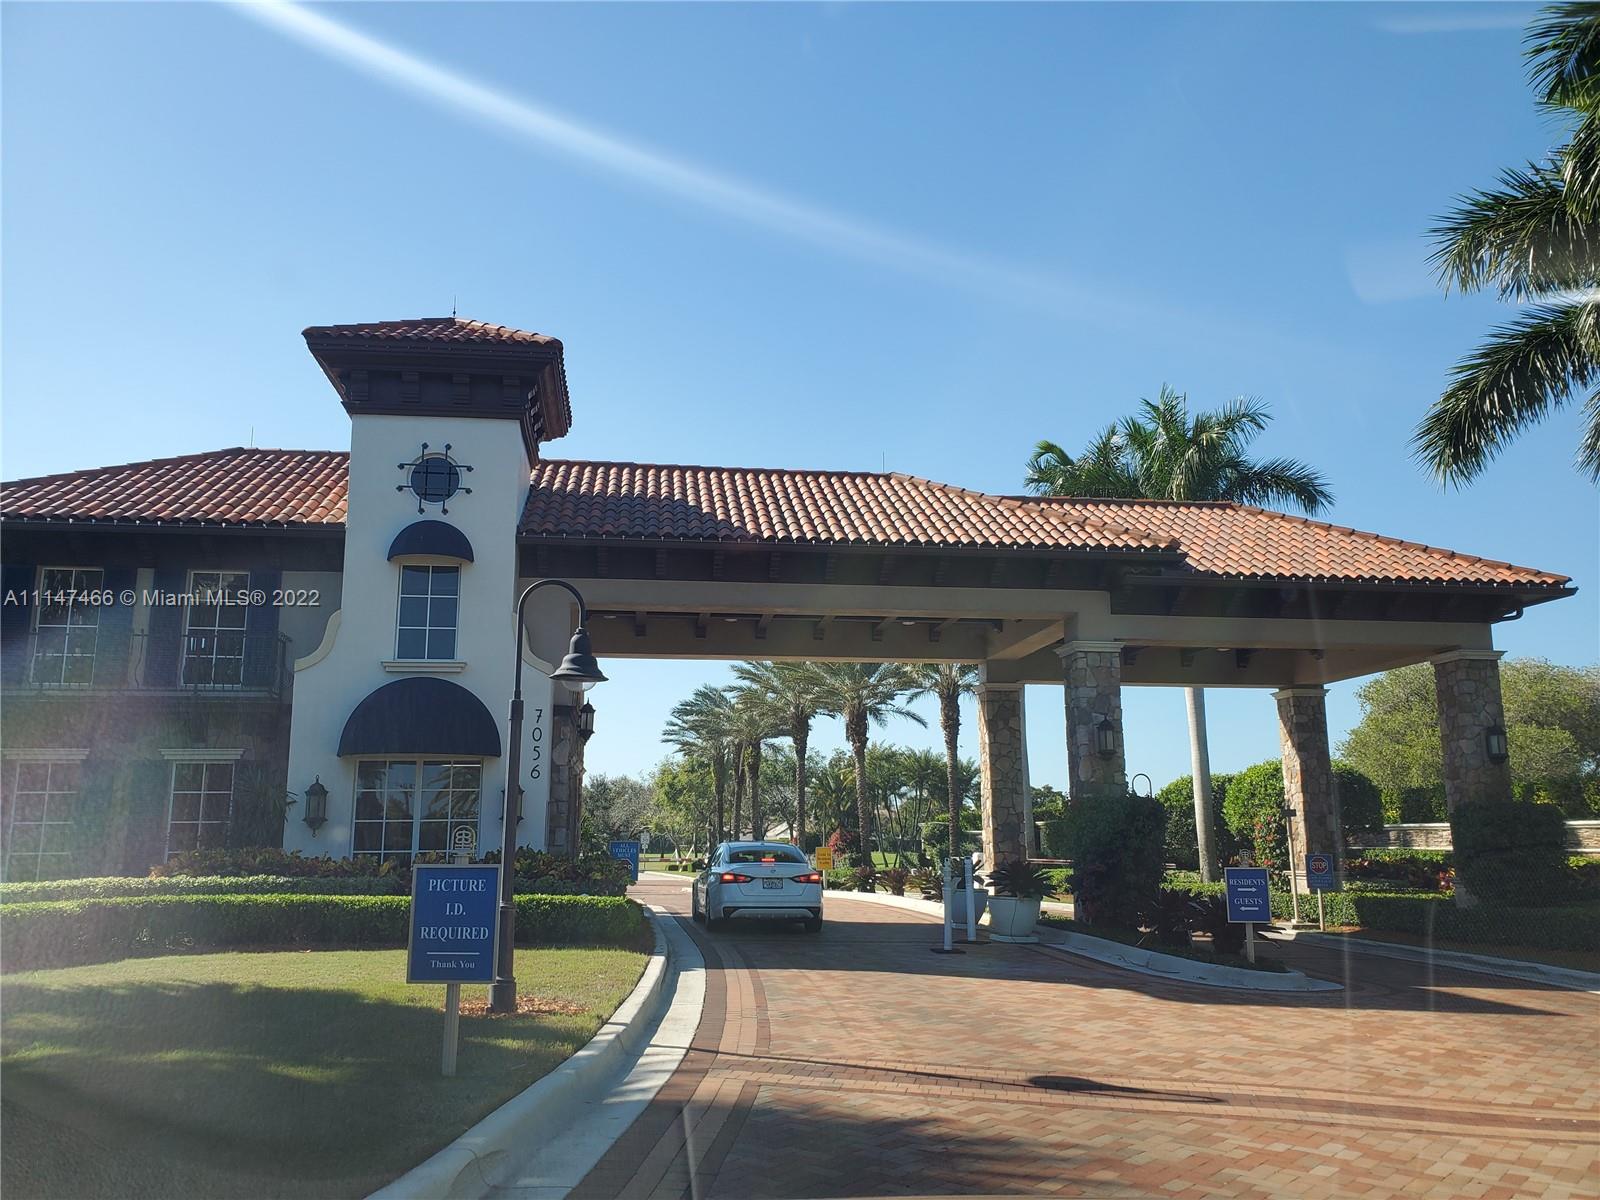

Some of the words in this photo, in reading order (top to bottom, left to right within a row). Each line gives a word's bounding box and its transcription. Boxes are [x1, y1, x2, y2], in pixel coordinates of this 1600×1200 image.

[530, 708, 543, 779] 7056
[1311, 860, 1328, 869] STOP
[428, 879, 486, 892] PICTURE
[1229, 878, 1266, 886] RESIDENTS
[1234, 897, 1263, 905] GUESTS
[445, 902, 467, 916] I.D.
[420, 926, 489, 941] REQUIRED
[430, 959, 457, 969] Thank
[459, 960, 475, 969] You
